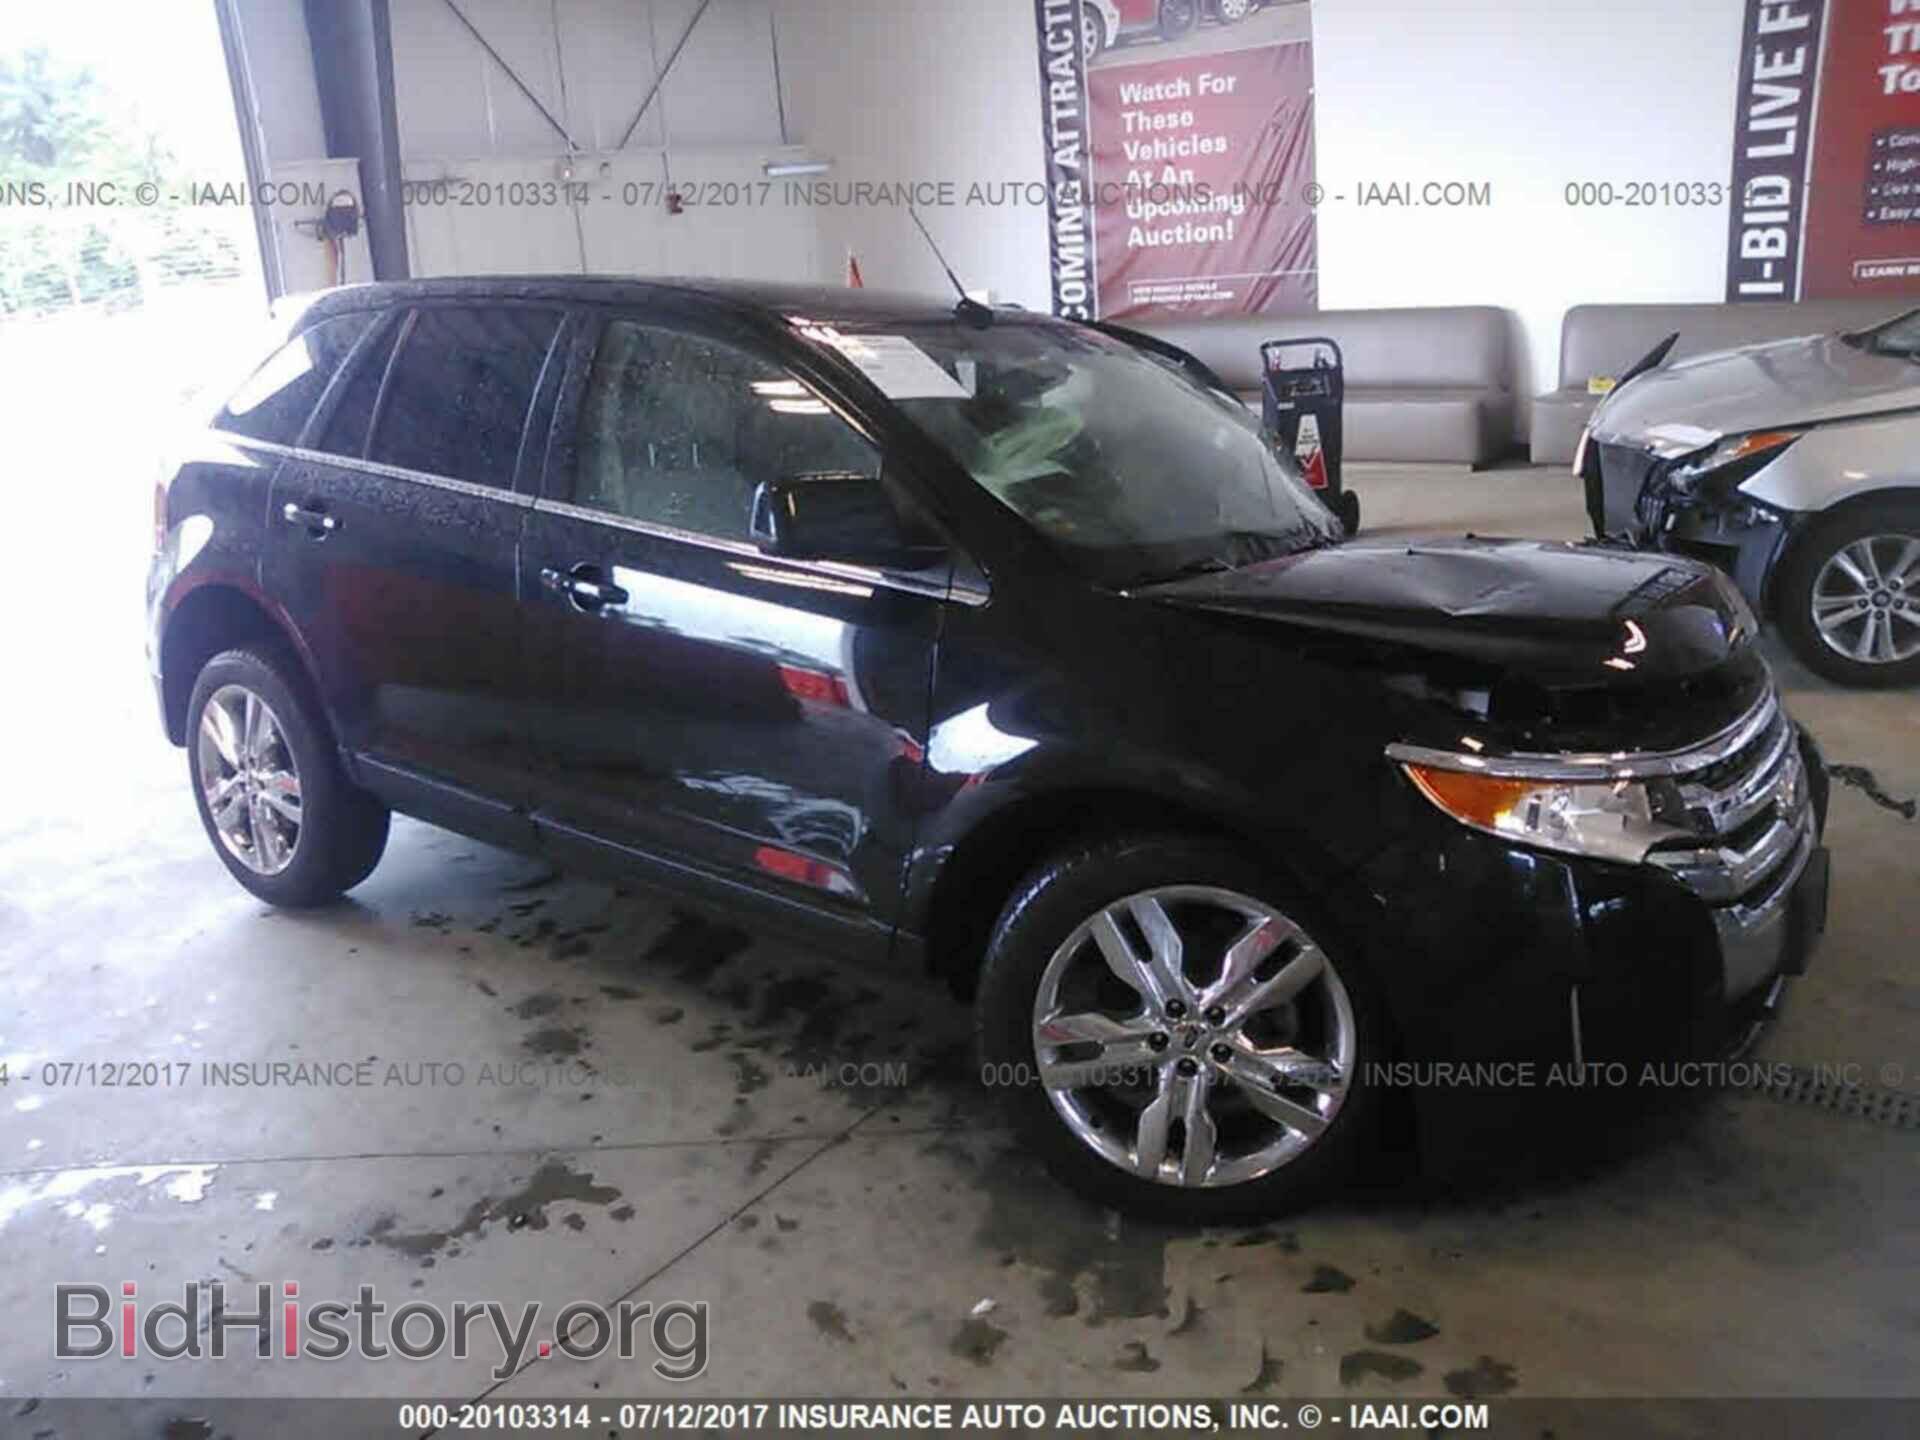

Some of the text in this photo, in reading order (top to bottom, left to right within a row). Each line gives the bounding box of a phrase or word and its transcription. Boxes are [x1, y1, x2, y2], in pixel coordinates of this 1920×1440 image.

[1119, 72, 1237, 105] Watch For
[1746, 43, 1806, 159] LIVE
[1121, 109, 1194, 133] These
[1122, 133, 1228, 161] Vehicles
[1126, 164, 1195, 189] At An
[1127, 217, 1234, 248] Auction!
[1738, 174, 1791, 294] I-BID
